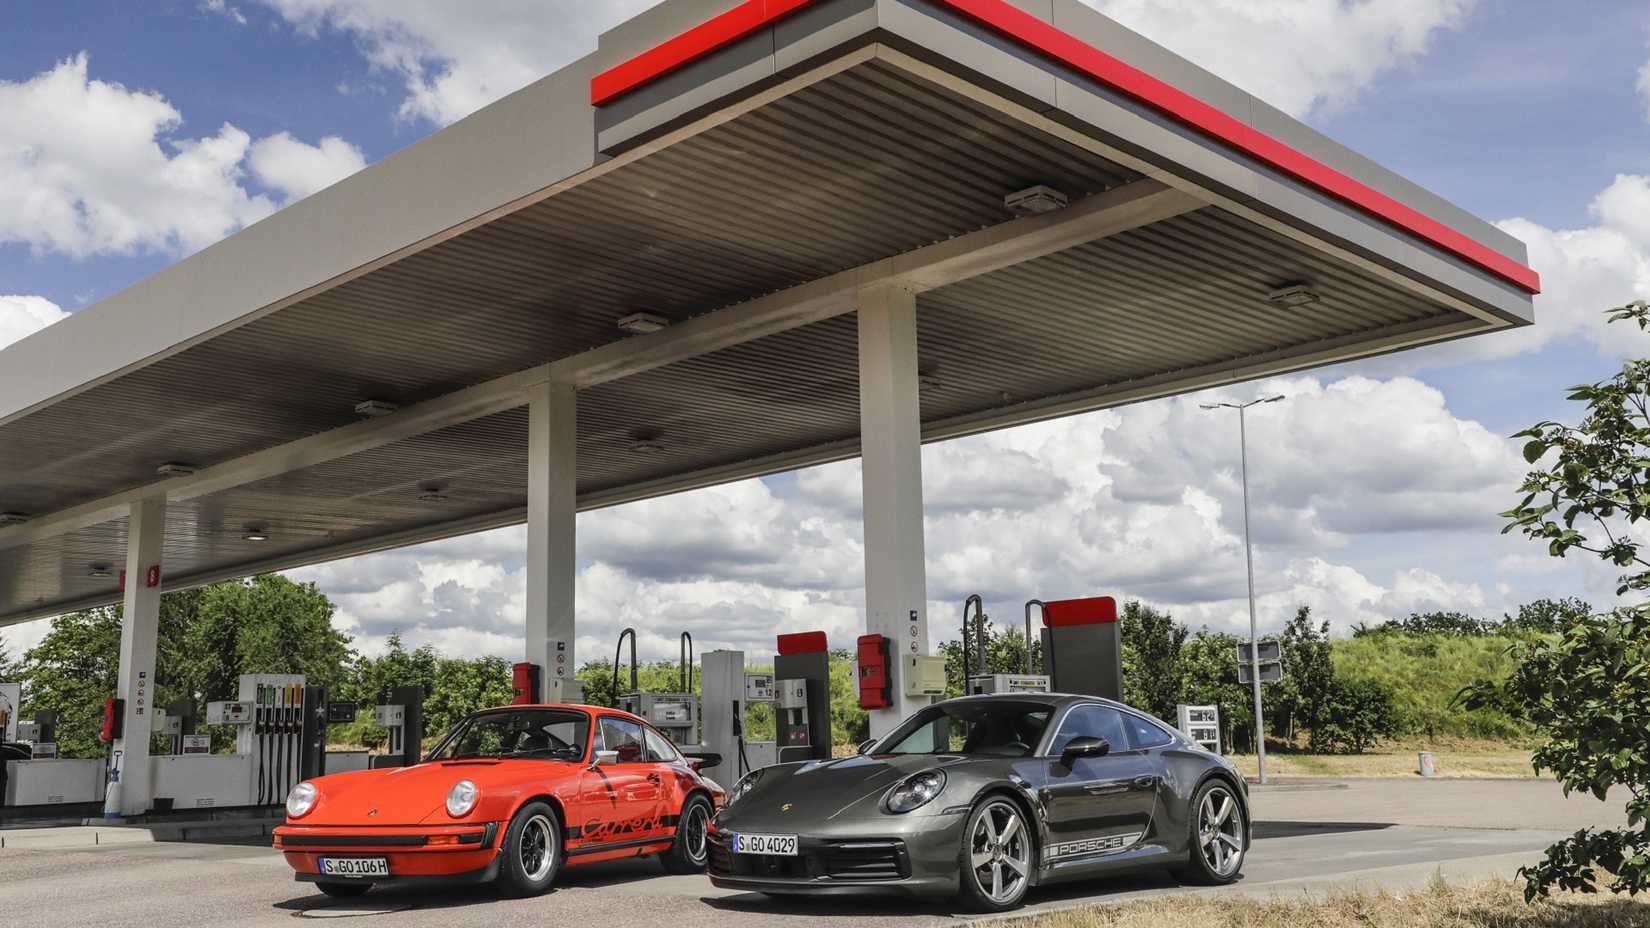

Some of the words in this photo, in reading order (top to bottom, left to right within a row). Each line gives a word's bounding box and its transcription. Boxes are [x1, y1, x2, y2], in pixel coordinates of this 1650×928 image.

[582, 816, 663, 838] Carrera
[739, 836, 745, 851] S
[751, 837, 765, 852] GO
[767, 838, 795, 853] 4029
[1060, 837, 1121, 854] PORSCHE
[326, 860, 334, 873] S
[339, 861, 354, 873] GO
[355, 861, 377, 873] 106
[378, 861, 387, 873] H
